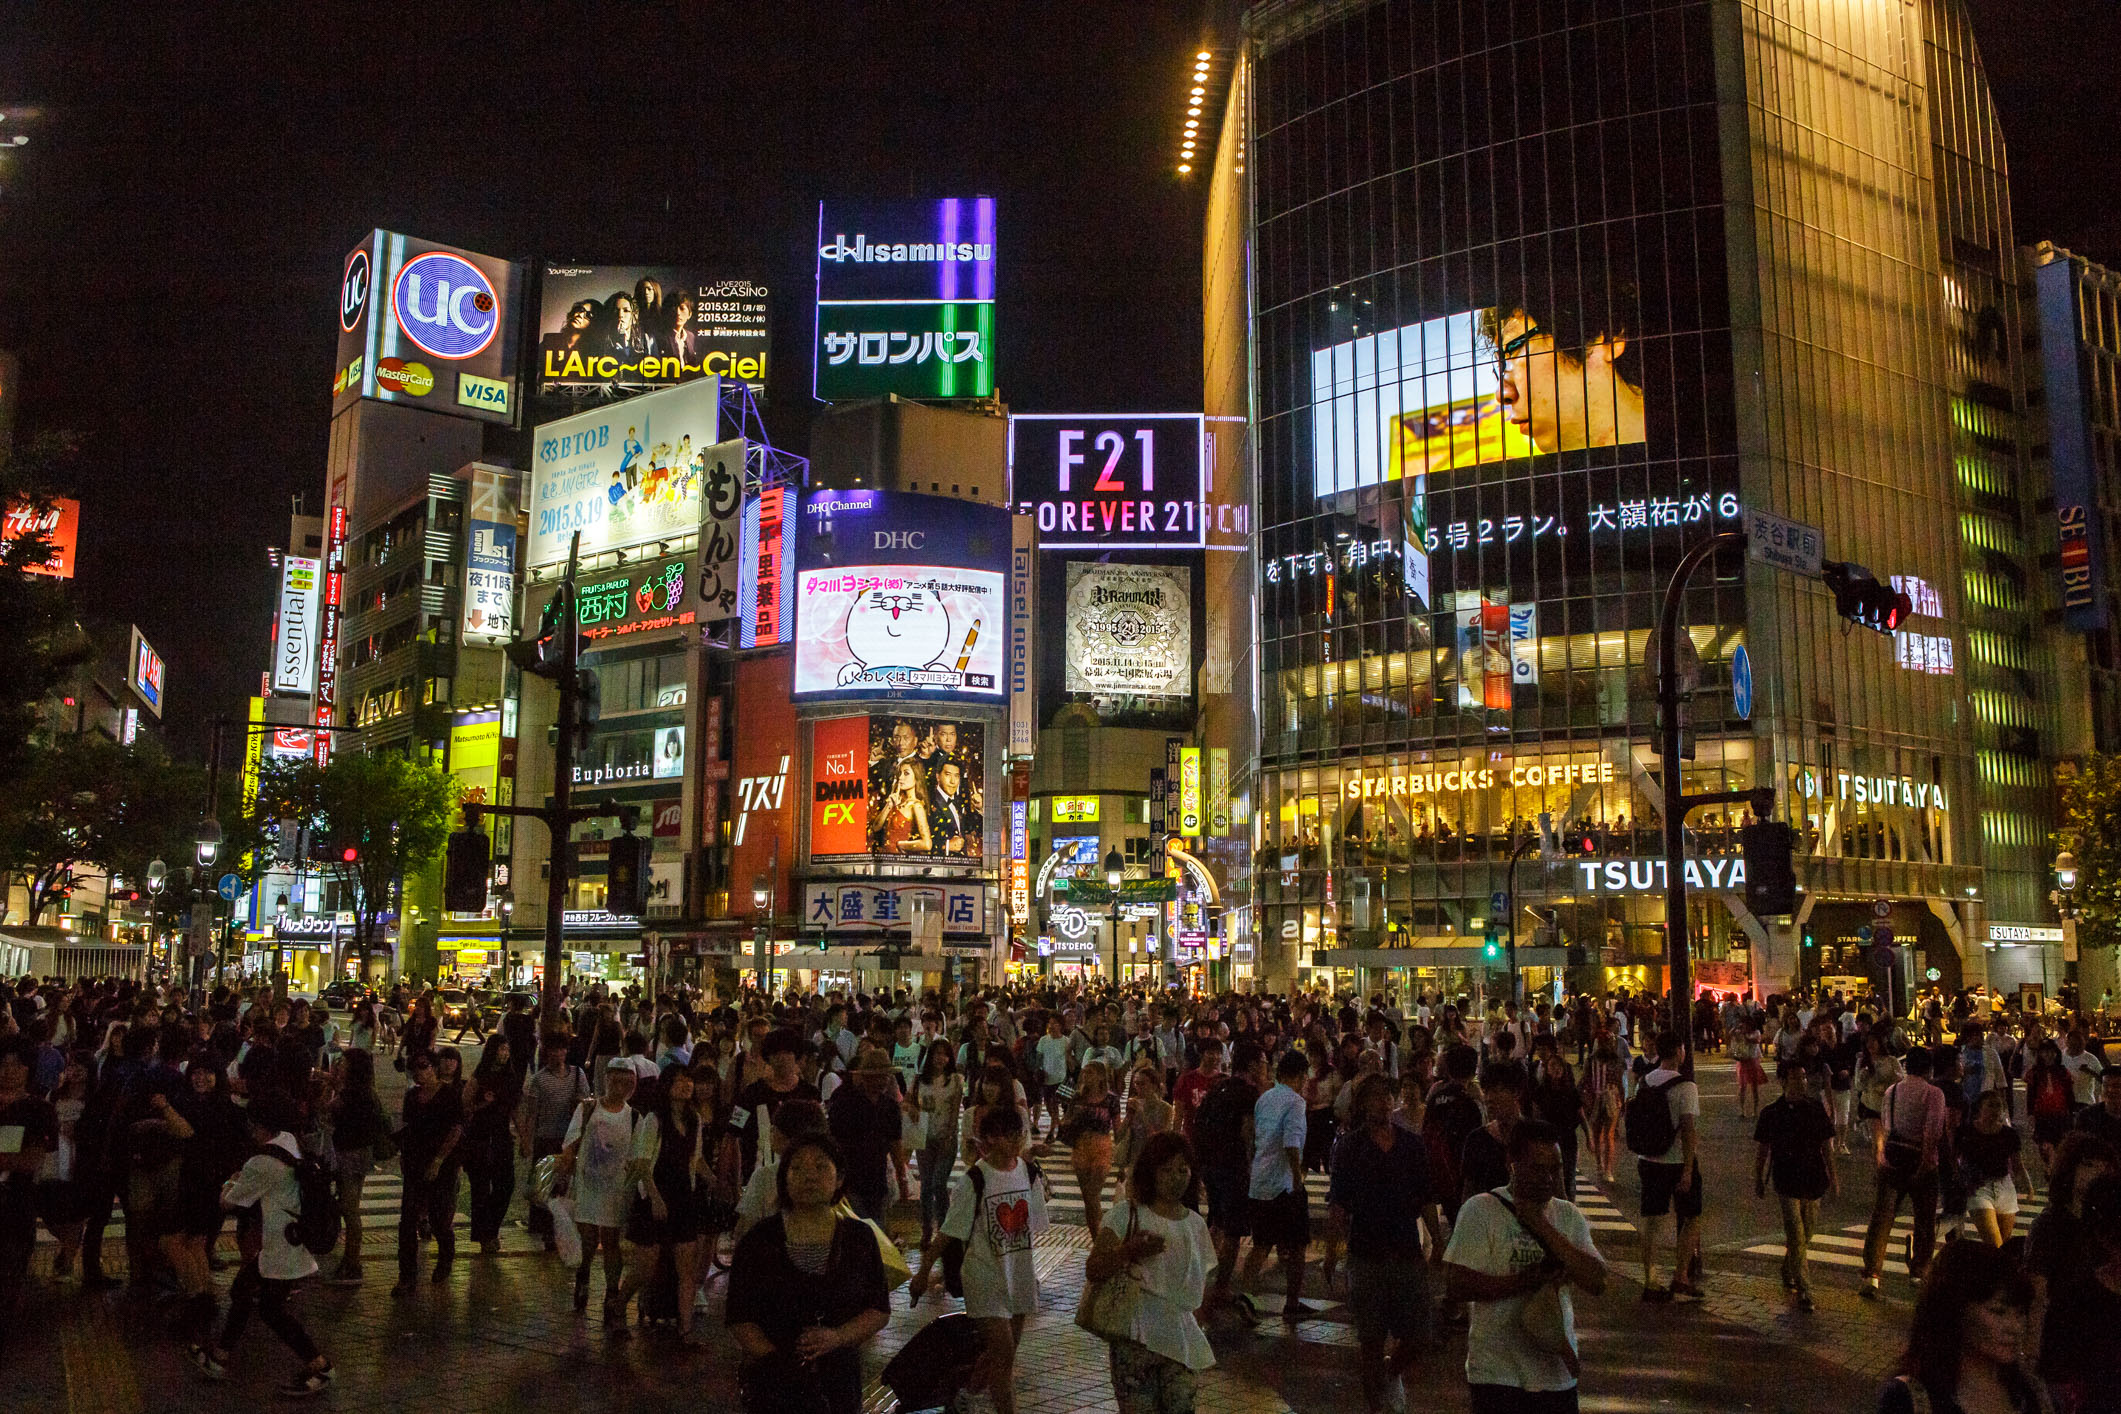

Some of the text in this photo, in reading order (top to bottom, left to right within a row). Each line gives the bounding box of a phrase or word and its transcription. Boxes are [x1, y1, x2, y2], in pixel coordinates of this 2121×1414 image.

[820, 234, 992, 262] Hisamitsu
[697, 302, 740, 312] 2015.9.21
[697, 313, 741, 322] 2015.9.22
[824, 331, 984, 364] サロンパス
[376, 366, 433, 387] MasterCard
[465, 383, 506, 405] VISA
[561, 424, 609, 459] BTOB
[1058, 429, 1154, 492] F21
[539, 495, 603, 536] 2015.8.19
[807, 499, 872, 514] DHC Channel
[1164, 501, 1194, 532] 21
[700, 461, 742, 613] もんじゃ
[873, 531, 925, 550] DHC
[1754, 516, 1817, 556] 渋谷駅前
[755, 493, 784, 637] 三千里薬品
[469, 571, 512, 591] 夜11時
[477, 589, 503, 606] まで
[487, 613, 510, 631] 地下
[1095, 622, 1117, 634] 1995
[1140, 624, 1161, 634] 2015
[278, 588, 305, 688] Essential
[1013, 627, 1026, 693] neon
[912, 672, 959, 683] タマ川ヨシ子
[971, 675, 989, 687] 検索
[572, 760, 650, 784] Euphoria
[826, 749, 856, 776] No.1
[815, 779, 864, 802] DMM
[1347, 761, 1614, 799] STARBUCKS COFFEE
[1838, 773, 1945, 811] TSUTAYA
[655, 804, 682, 829] JTB
[822, 802, 856, 826] FX
[1183, 815, 1197, 827] 4F
[1014, 867, 1027, 890] 焼肉
[1579, 859, 1746, 890] TSUTAYA
[812, 890, 975, 923] 大盛堂店
[1990, 926, 2031, 940] TSUTAYA
